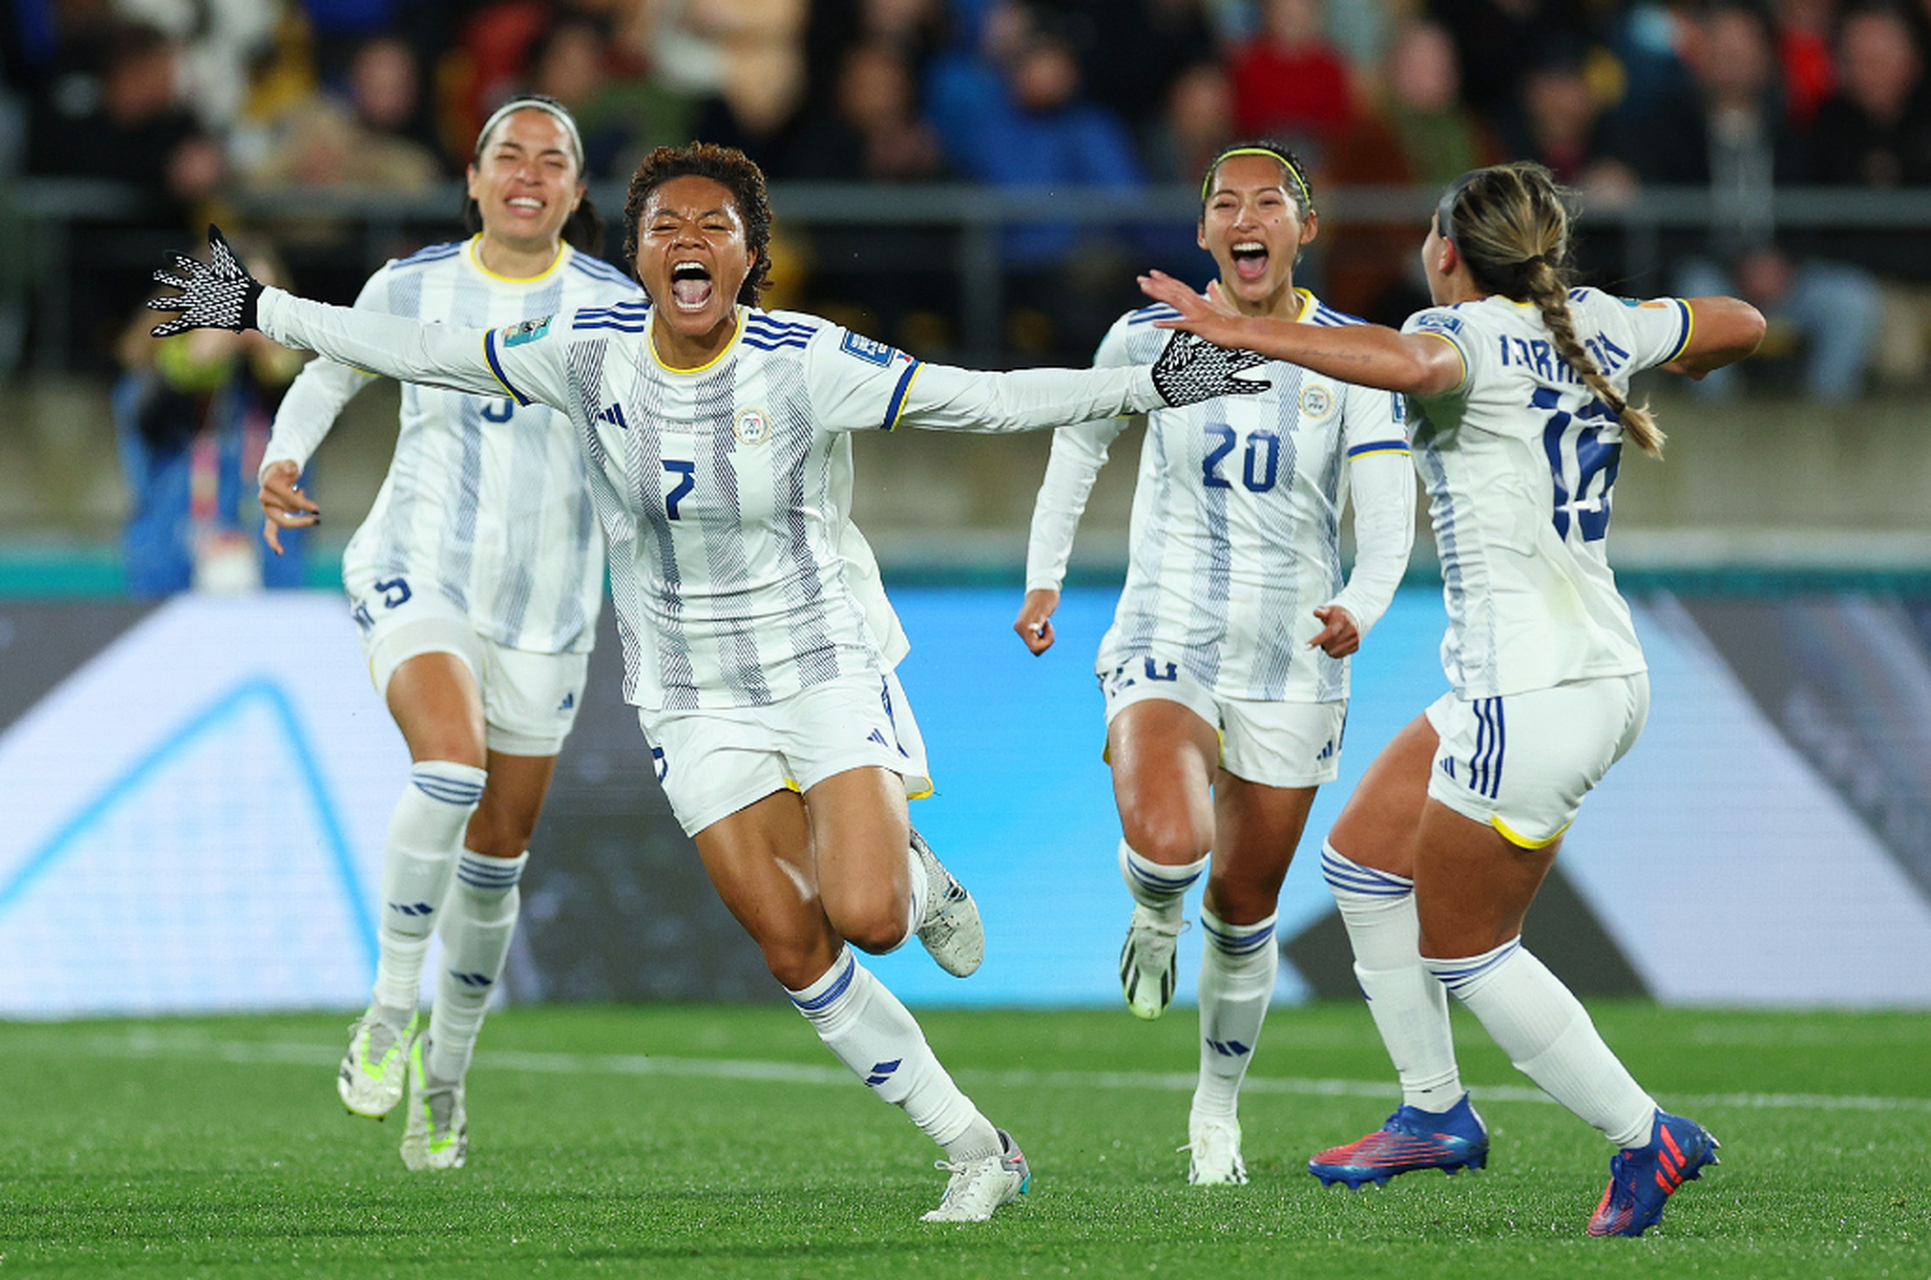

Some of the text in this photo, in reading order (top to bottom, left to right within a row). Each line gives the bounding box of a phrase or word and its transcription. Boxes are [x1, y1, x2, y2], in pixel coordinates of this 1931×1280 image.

[661, 460, 695, 521] 7
[1202, 423, 1281, 493] 20
[1527, 387, 1623, 543] 16
[374, 576, 412, 609] 5
